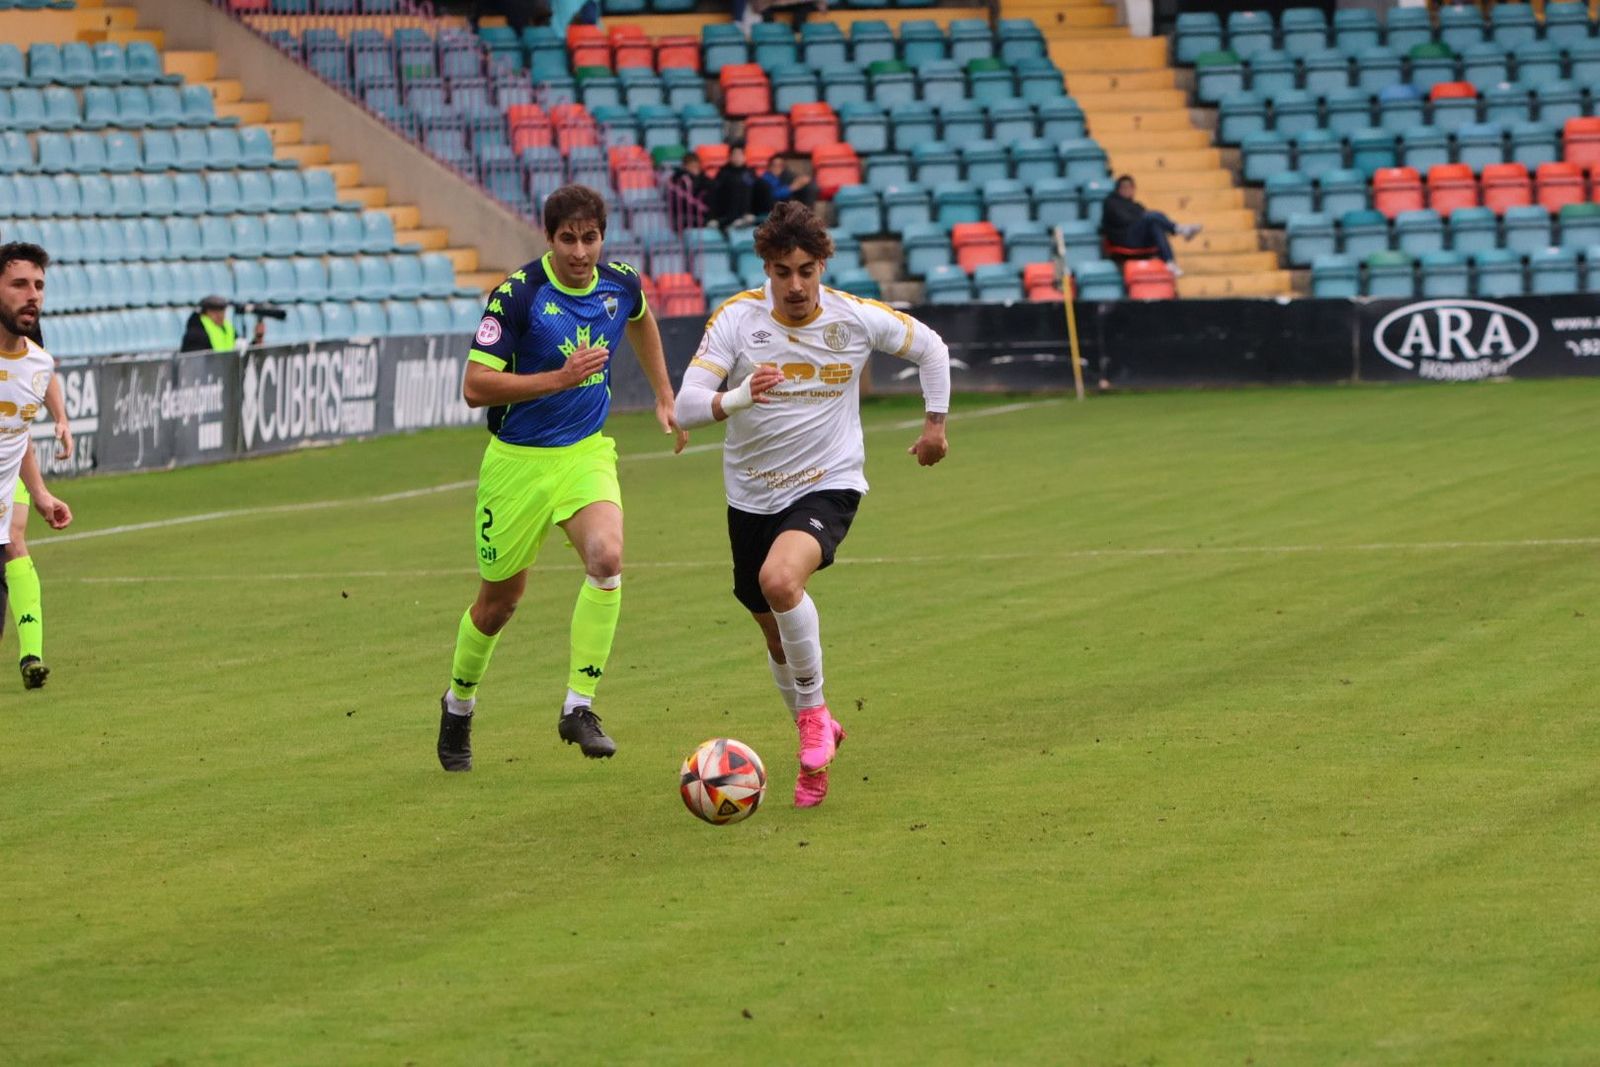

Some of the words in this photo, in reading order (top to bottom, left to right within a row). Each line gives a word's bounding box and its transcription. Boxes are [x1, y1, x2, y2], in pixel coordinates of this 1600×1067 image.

[1399, 307, 1516, 360] ARA
[258, 350, 342, 443] CUBERS
[342, 344, 378, 398] HIELO
[481, 506, 493, 543] 2
